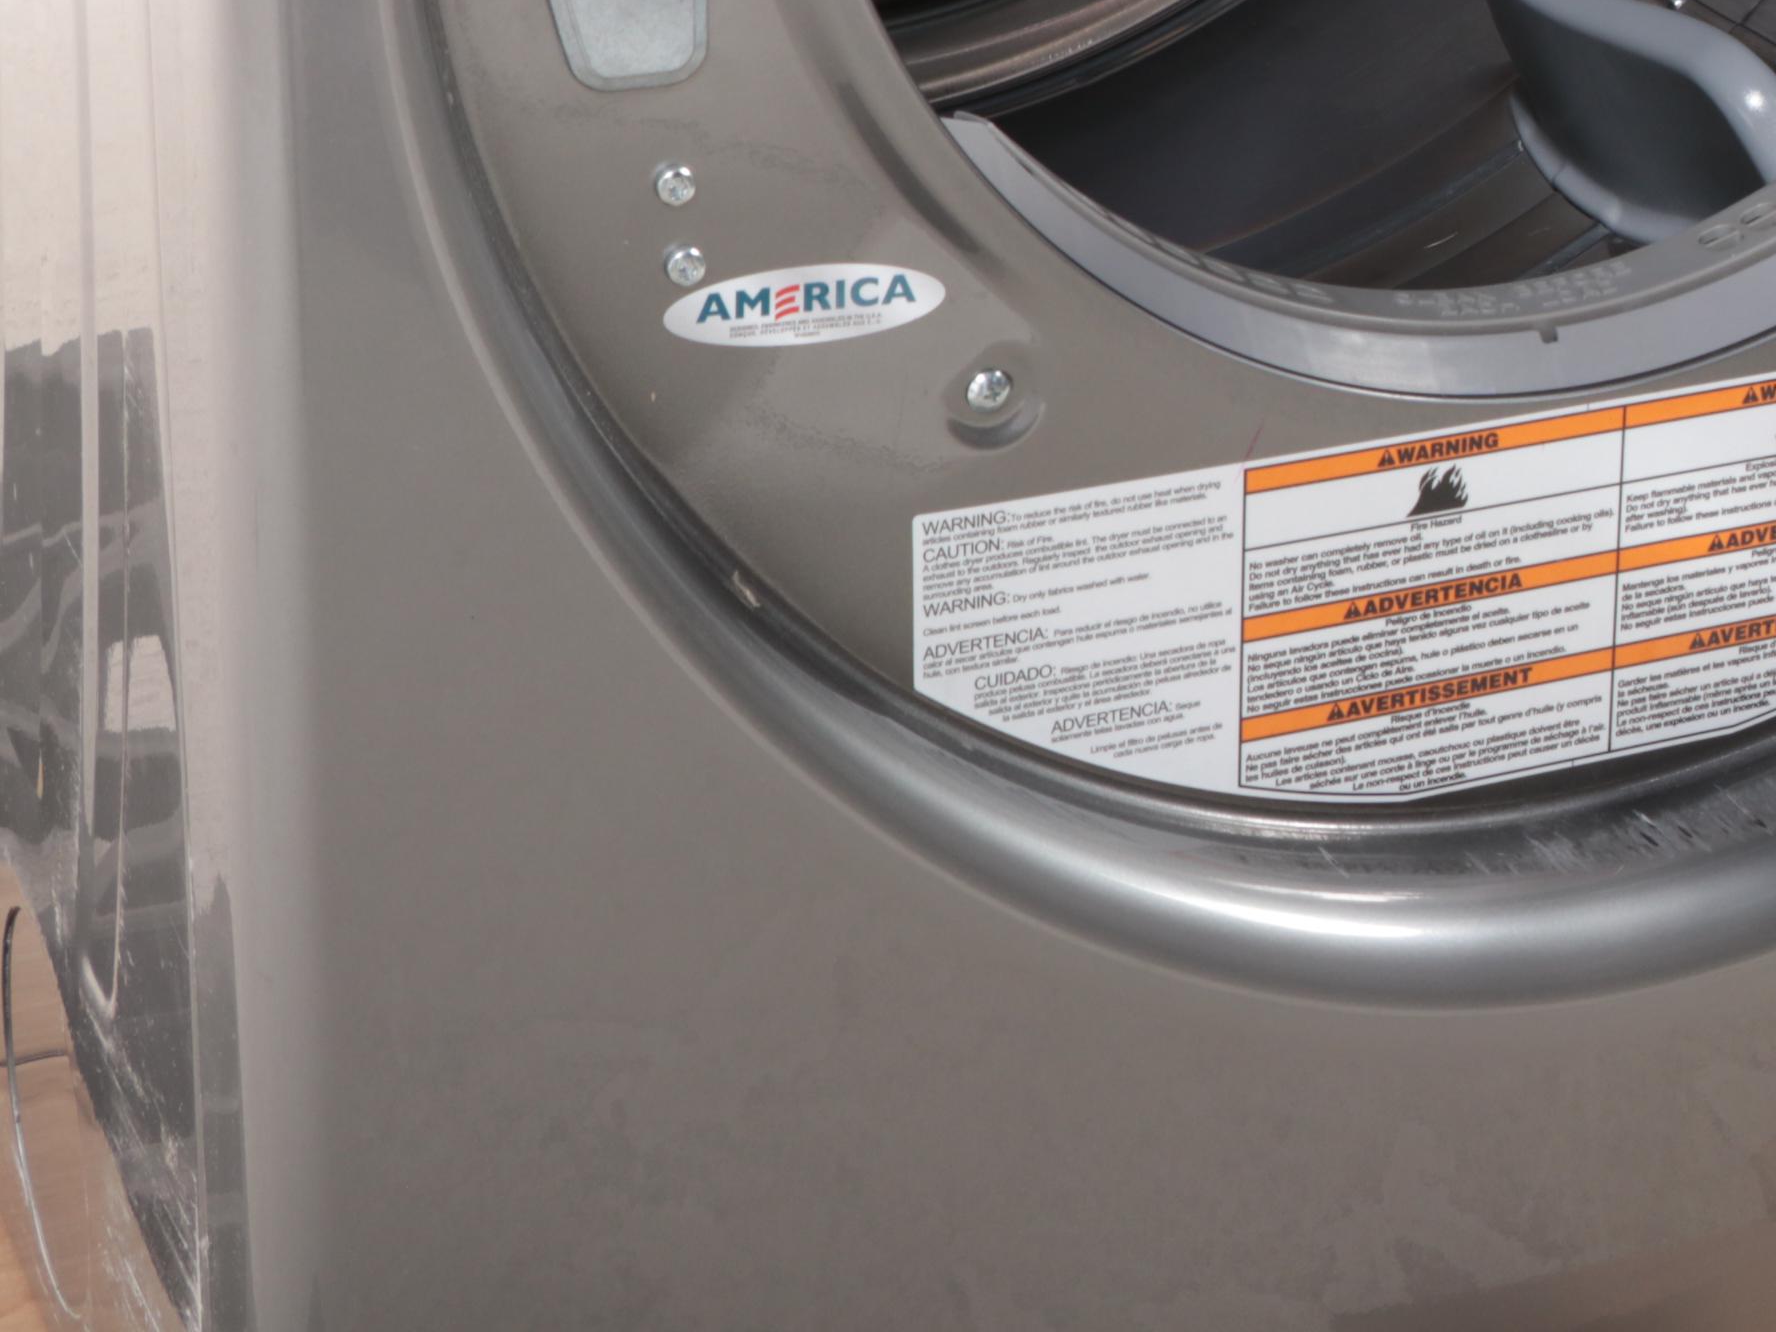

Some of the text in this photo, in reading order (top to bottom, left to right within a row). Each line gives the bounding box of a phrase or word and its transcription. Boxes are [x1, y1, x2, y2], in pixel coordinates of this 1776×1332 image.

[696, 274, 916, 324] AMERICA
[1397, 431, 1498, 464] WARNING
[1625, 504, 1638, 512] Do
[1640, 500, 1654, 510] not
[1656, 498, 1670, 507] dry
[1672, 491, 1710, 504] anything
[1712, 486, 1729, 496] that
[1731, 484, 1746, 493] has
[1748, 481, 1767, 490] ever
[1626, 493, 1648, 502] Keep
[1650, 483, 1695, 498] flammable
[1697, 476, 1736, 489] materials
[1738, 471, 1755, 482] and
[922, 509, 1010, 536] WARNING:
[1410, 515, 1461, 531] Fire Hazard
[1625, 521, 1654, 532] Failure
[1667, 514, 1693, 524] follow
[1695, 509, 1719, 519] these
[1721, 499, 1771, 514] instructions
[923, 537, 1004, 563] CAUTION:
[1249, 508, 1614, 581] Do not dry anything that has ever had any type of oil on it (including cooking oils).
[1249, 532, 1423, 571] No washer can completely remove oil.
[1249, 580, 1274, 591] Items
[1277, 571, 1325, 585] containing
[1327, 566, 1353, 576] foam,
[1356, 560, 1388, 571] rubber,
[1390, 557, 1400, 565] or
[1402, 551, 1432, 565] plastic
[1435, 545, 1457, 557] must
[1459, 544, 1471, 552] be
[1473, 538, 1496, 550] dried
[1498, 537, 1510, 545] on
[1520, 527, 1567, 541] clothesline
[1581, 522, 1592, 531] by
[1248, 556, 1521, 611] Failure to follow these instructions can result in death or fire.
[1248, 579, 1333, 601] using an Air Cycle.
[1363, 571, 1522, 616] ADVERTENCIA
[924, 590, 1009, 618] WARNING:
[1385, 604, 1471, 626] Peligro de Incendio
[923, 626, 1048, 661] ADVERTENCIA:
[974, 663, 1056, 691] CUIDADO:
[1347, 666, 1532, 717] AVERTISSEMENT
[1051, 699, 1172, 735] ADVERTENCIA:
